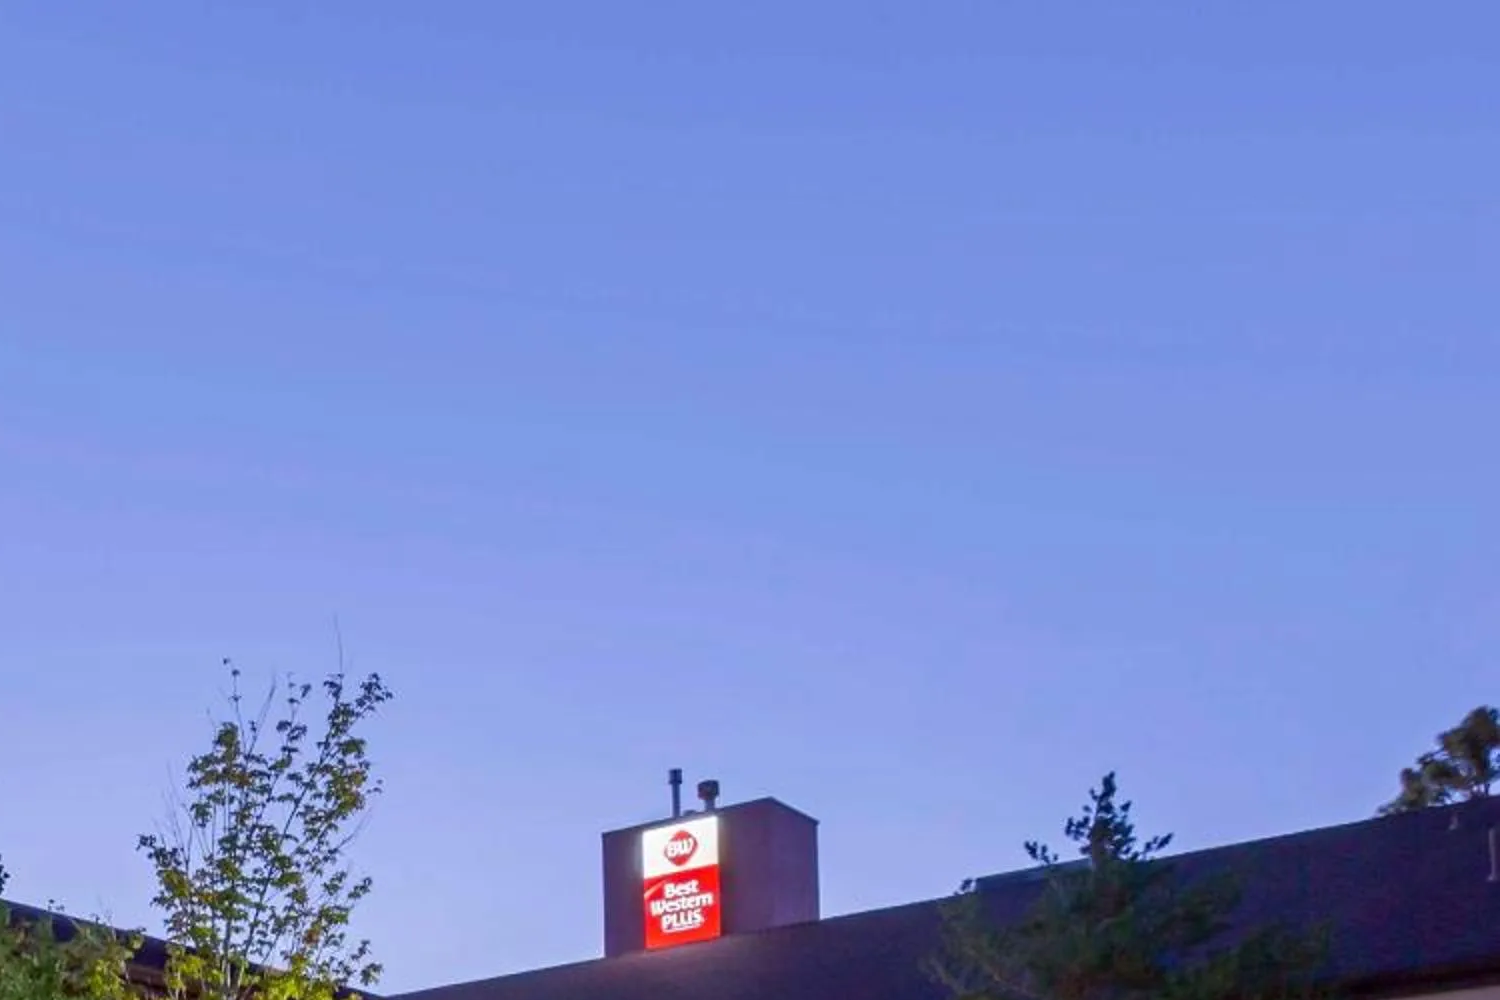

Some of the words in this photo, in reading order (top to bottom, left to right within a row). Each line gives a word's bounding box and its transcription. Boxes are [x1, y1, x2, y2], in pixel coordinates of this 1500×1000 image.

[664, 879, 699, 898] Best
[650, 892, 714, 917] Western
[661, 908, 705, 933] PLUS
